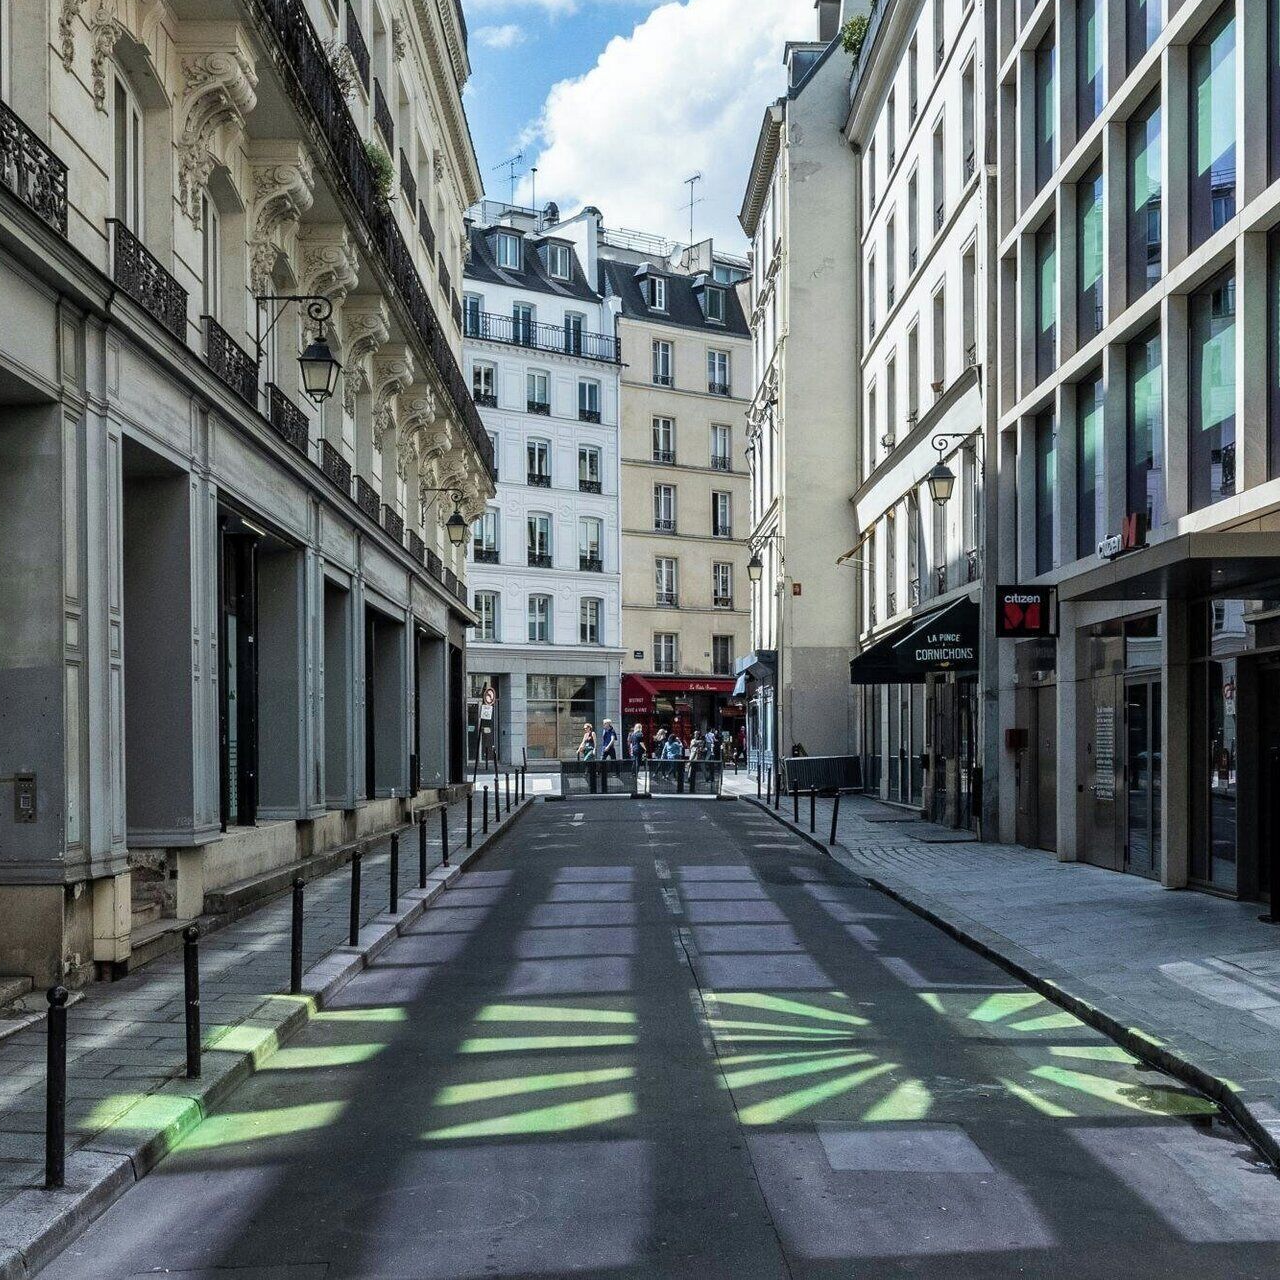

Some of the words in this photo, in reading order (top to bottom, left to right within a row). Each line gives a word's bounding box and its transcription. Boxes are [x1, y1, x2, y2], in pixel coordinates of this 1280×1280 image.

[1004, 594, 1041, 604] citizen
[927, 634, 937, 643] LA
[939, 633, 961, 642] PINCE
[915, 647, 973, 661] CORNICHONS
